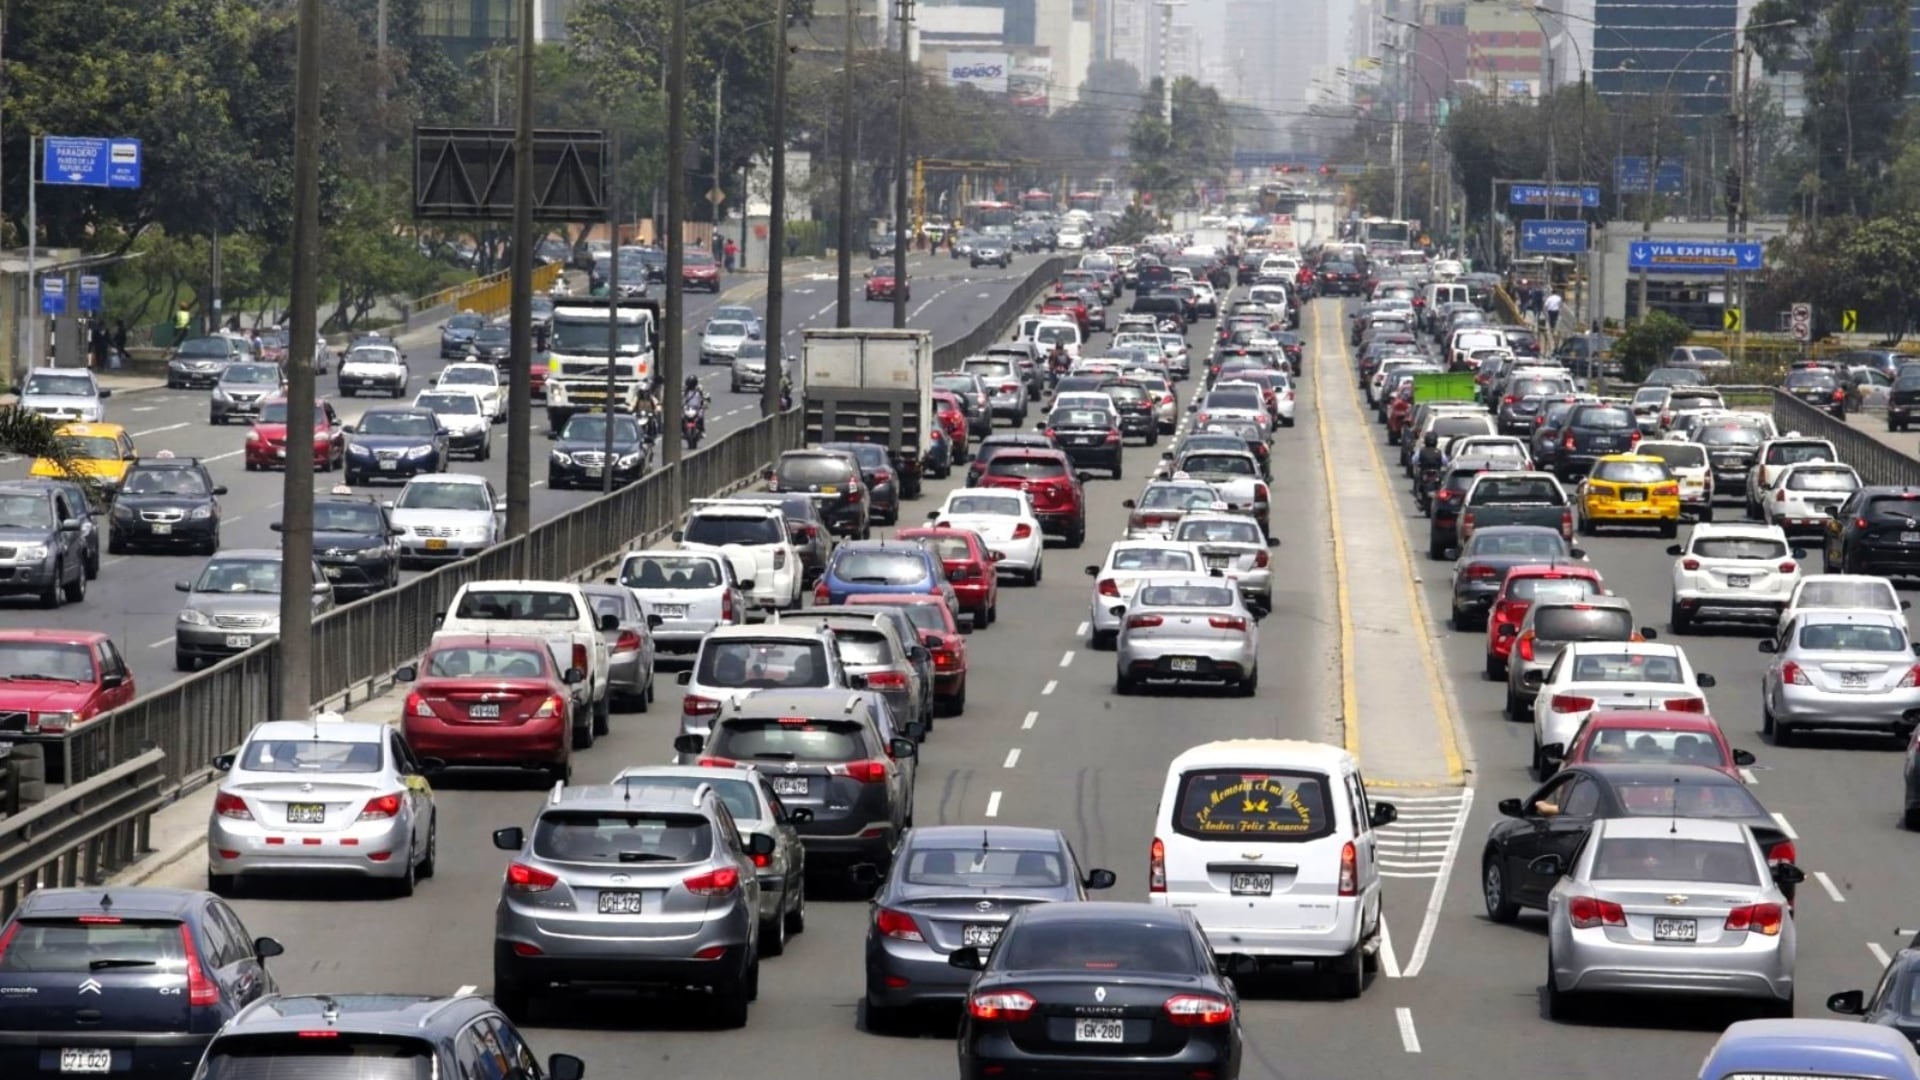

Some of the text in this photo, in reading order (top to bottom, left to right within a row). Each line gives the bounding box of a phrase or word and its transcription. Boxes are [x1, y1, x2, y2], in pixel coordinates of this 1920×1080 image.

[952, 66, 1003, 78] BEMBOS
[57, 148, 97, 157] PARADERO
[1650, 246, 1737, 257] VIA EXPRESA
[1233, 875, 1271, 890] AZP-049
[1656, 922, 1694, 936] ASP-691
[159, 987, 181, 995] C4
